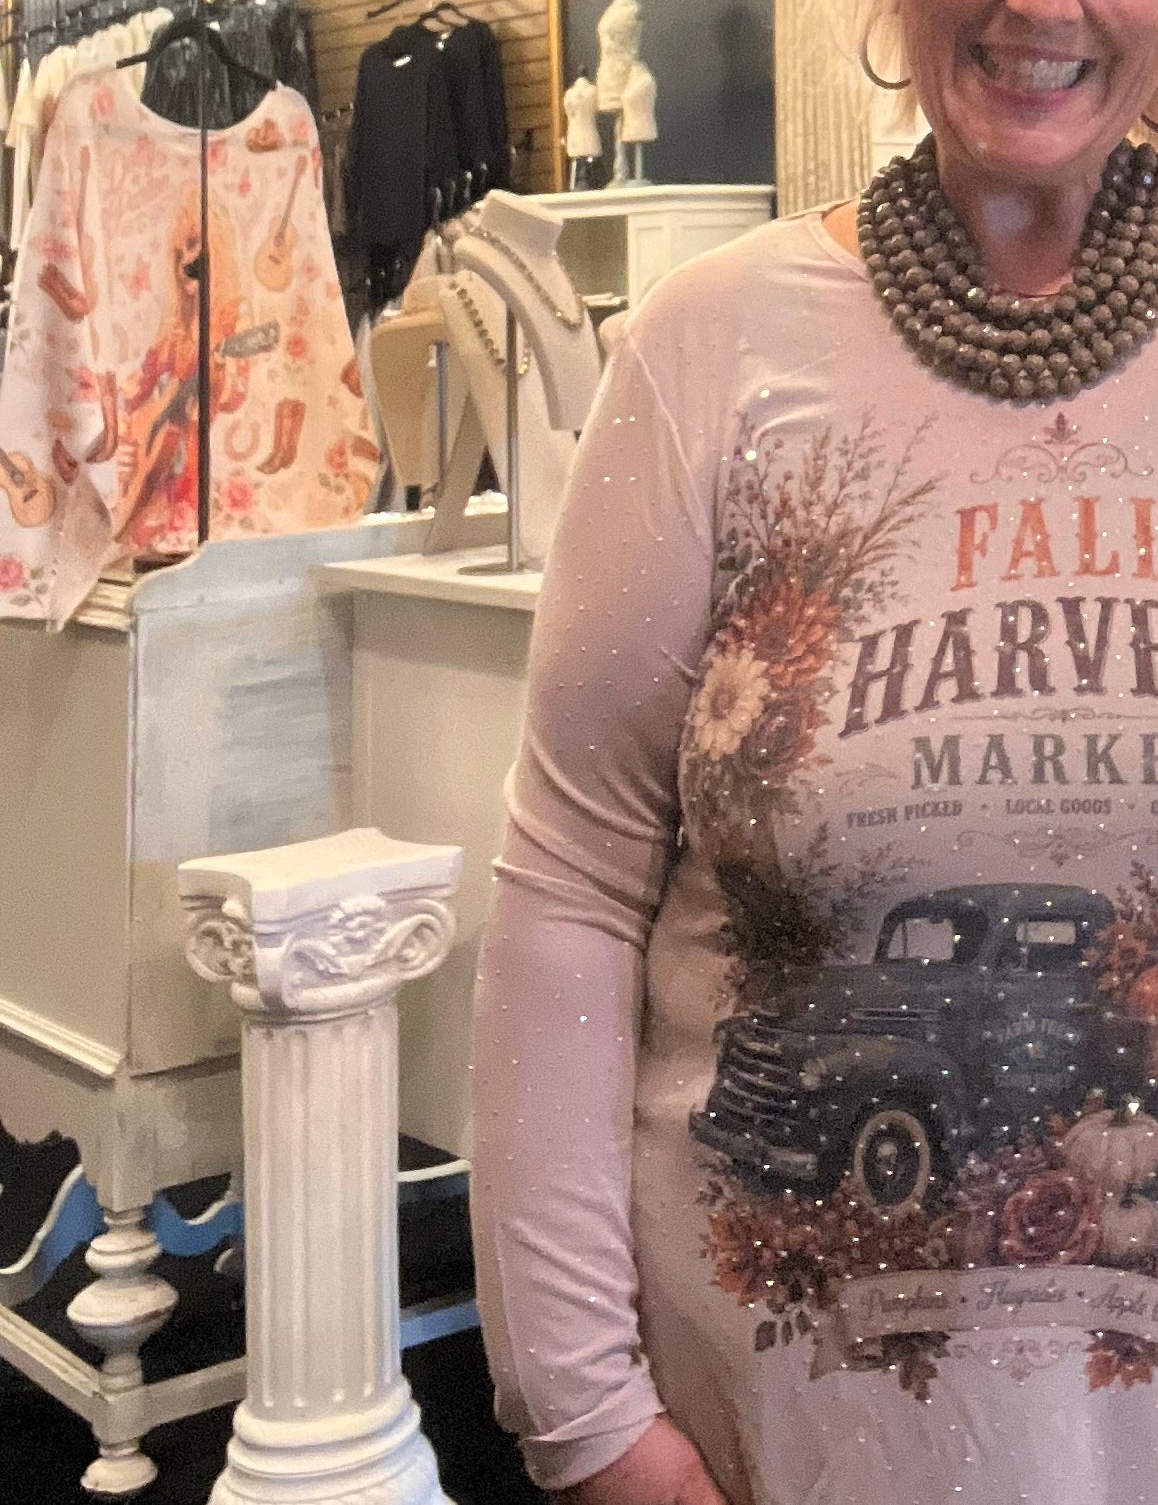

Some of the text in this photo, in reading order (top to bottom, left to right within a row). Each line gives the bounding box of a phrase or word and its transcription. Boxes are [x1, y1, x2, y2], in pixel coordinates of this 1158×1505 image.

[847, 806, 898, 828] FRESH
[904, 799, 963, 821] PICKED
[1005, 798, 1055, 815] LOCAL
[1060, 798, 1112, 815] GOODS
